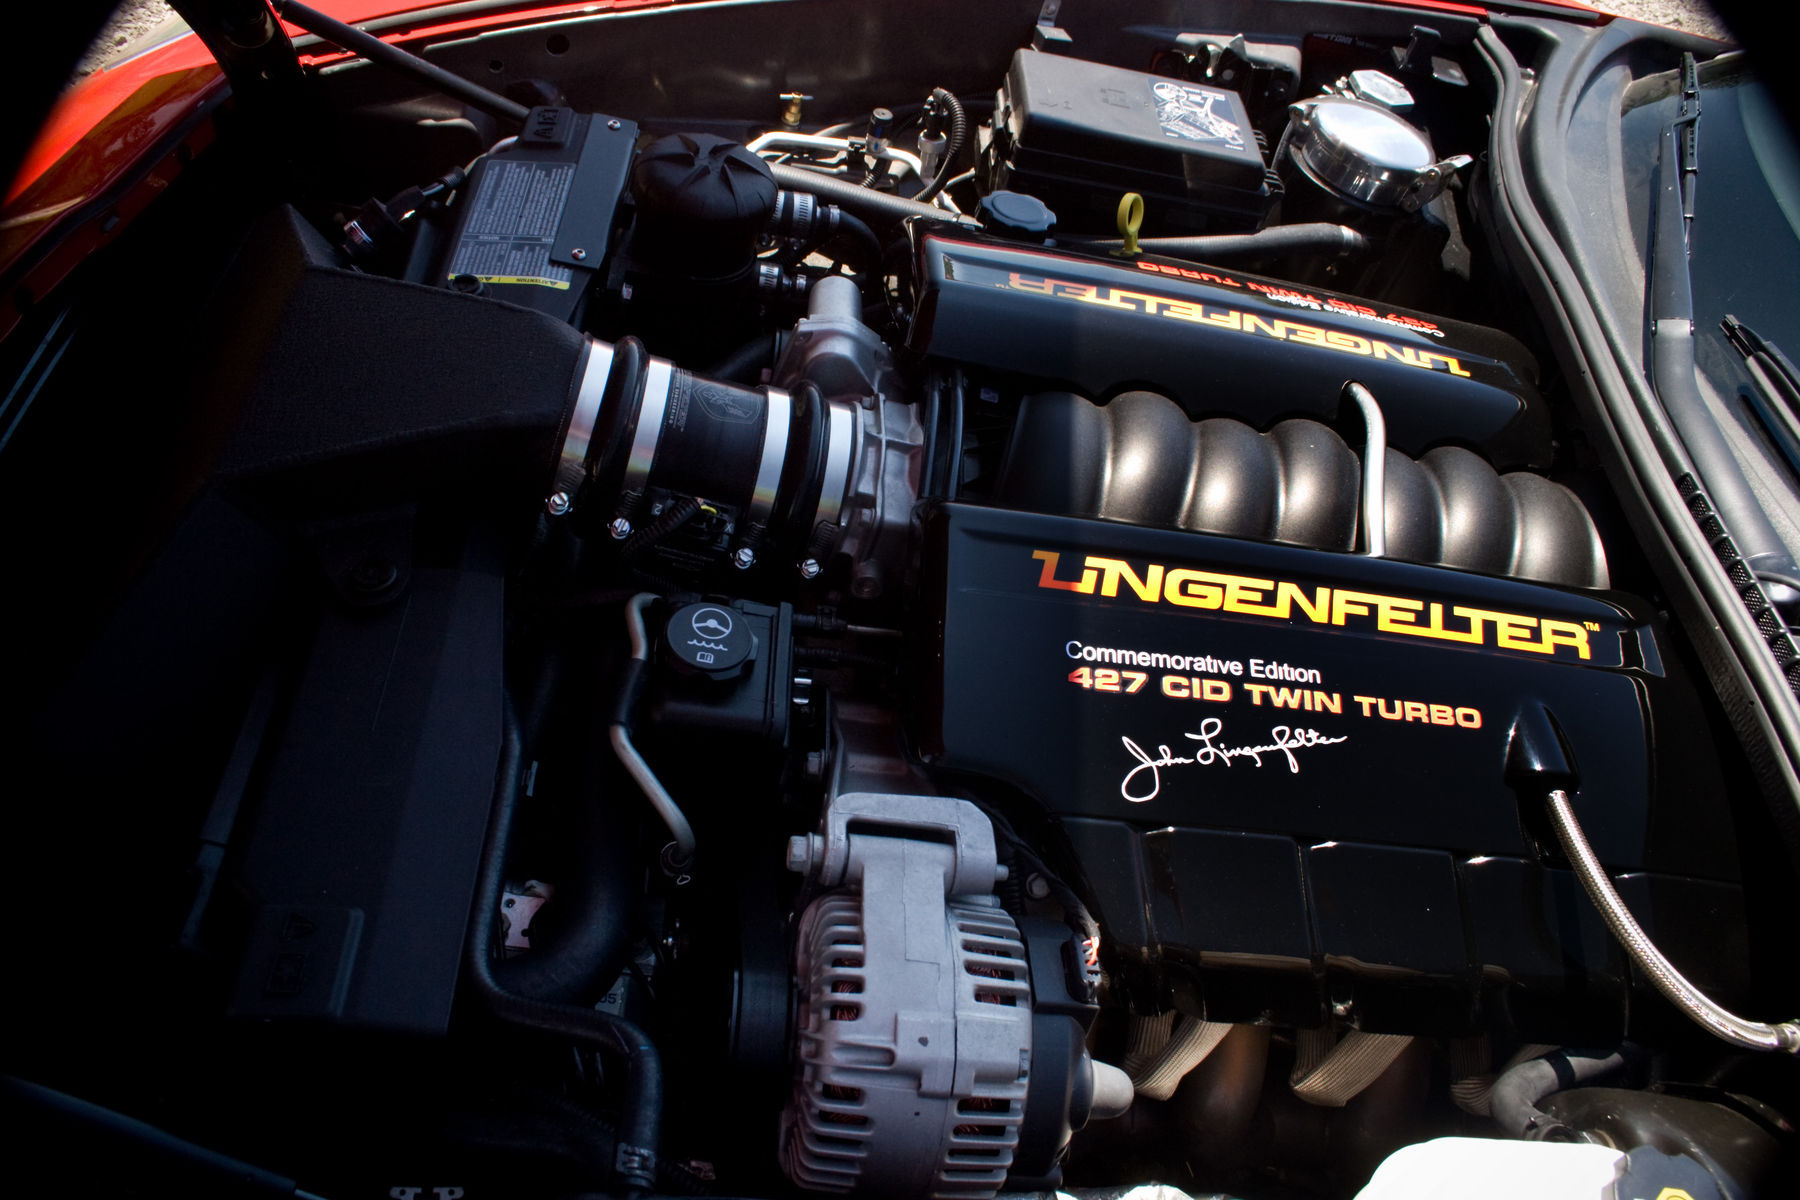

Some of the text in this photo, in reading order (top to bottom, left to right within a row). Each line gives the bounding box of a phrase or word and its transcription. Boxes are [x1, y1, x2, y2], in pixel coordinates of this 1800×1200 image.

[1009, 272, 1471, 377] LINGENFELTER
[1137, 261, 1438, 329] 427 CID TWIN TURBO
[1266, 293, 1445, 338] Commemorative Edition
[1032, 550, 1592, 660] LINGENFELTER
[1066, 640, 1321, 684] Commemorative Edition
[1068, 667, 1482, 728] 427 CID TWIN TURBO
[1121, 736, 1193, 802] John
